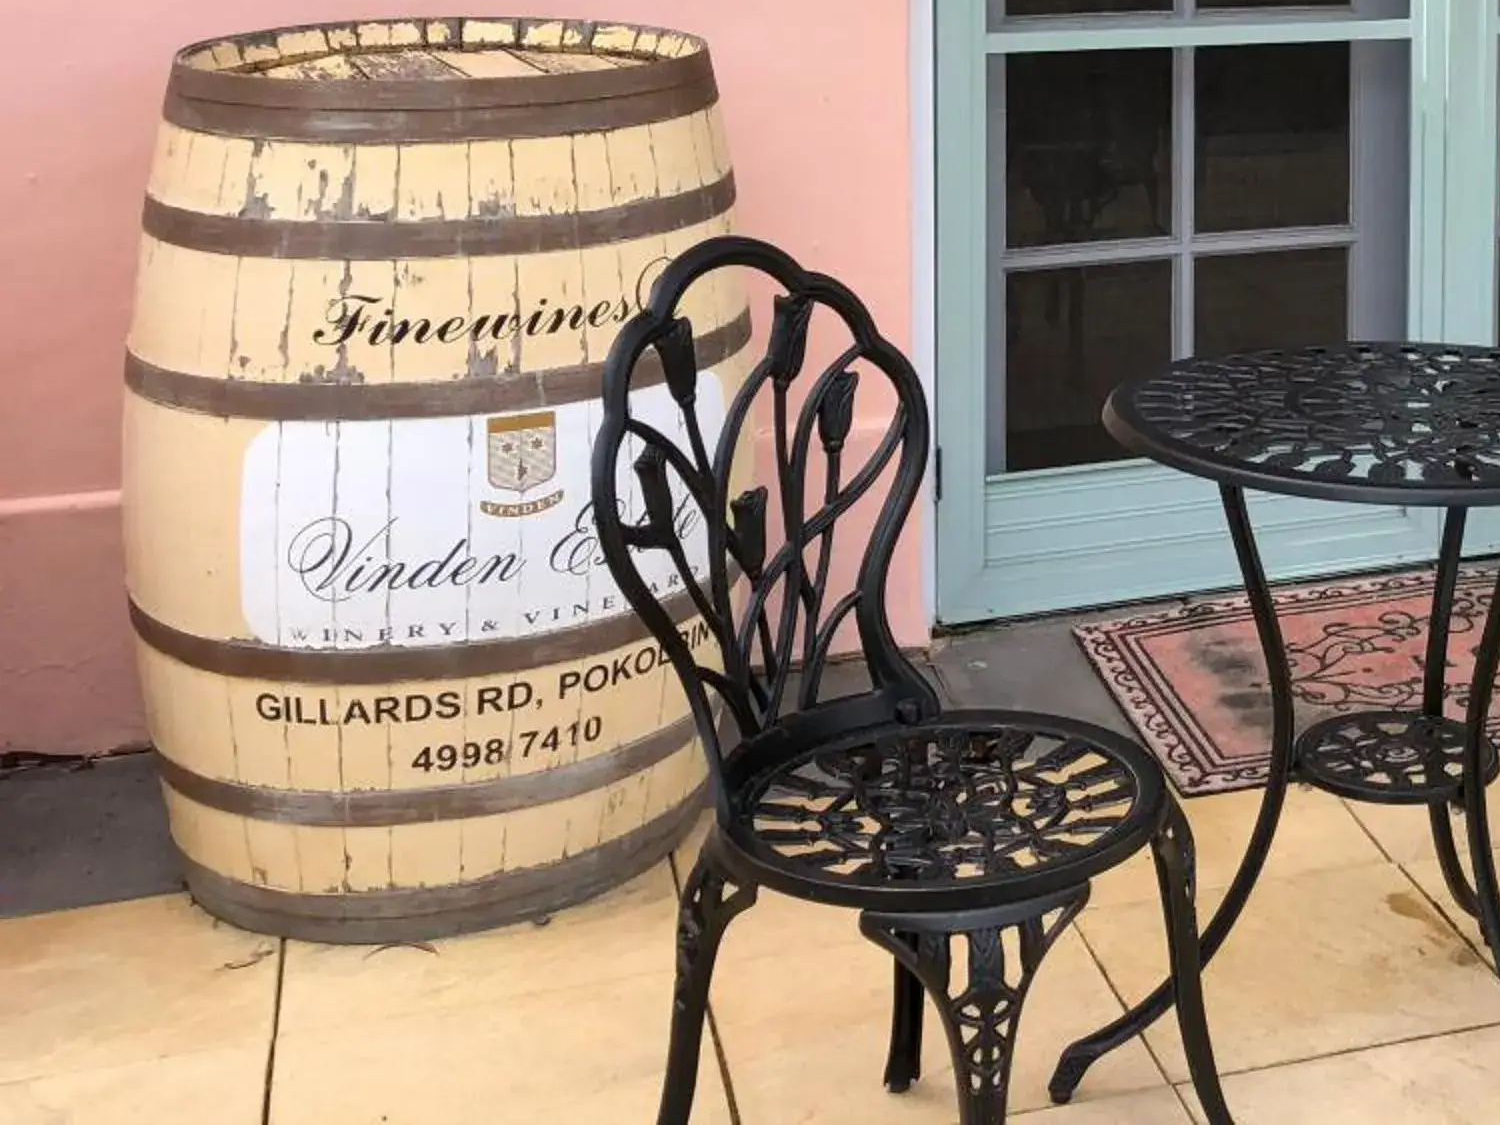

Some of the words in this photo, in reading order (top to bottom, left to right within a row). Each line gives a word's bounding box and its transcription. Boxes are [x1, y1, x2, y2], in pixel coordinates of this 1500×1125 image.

[486, 493, 560, 516] VINDEN
[288, 517, 525, 602] Vinden
[292, 621, 458, 642] WINERY
[481, 620, 498, 633] &
[524, 567, 699, 625] VINEAR
[256, 691, 461, 725] GILLARDS
[476, 682, 543, 715] RD,
[411, 733, 503, 773] 4998
[520, 716, 602, 760] 7410
